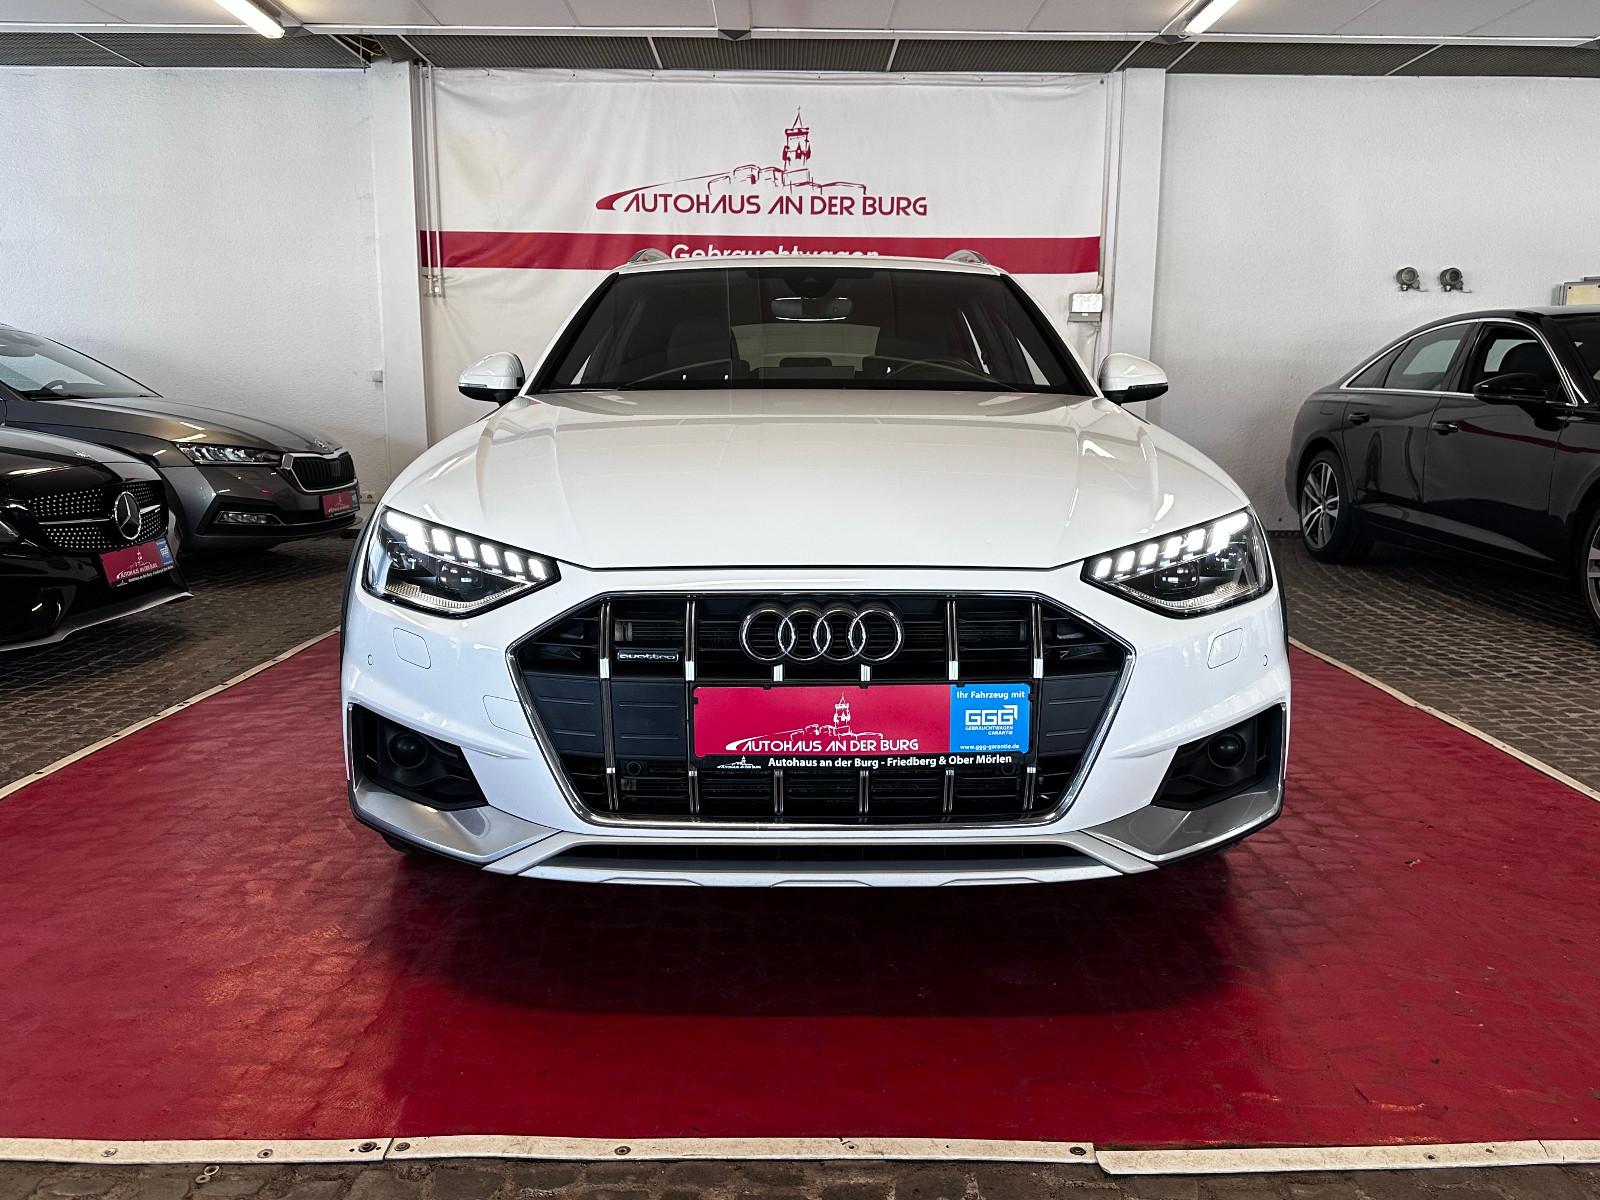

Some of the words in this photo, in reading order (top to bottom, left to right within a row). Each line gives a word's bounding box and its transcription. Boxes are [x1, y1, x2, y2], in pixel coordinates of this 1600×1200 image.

[623, 193, 761, 214] AUTOHAUS
[767, 195, 803, 215] AN
[810, 195, 855, 216] DER
[862, 196, 928, 216] BURG
[956, 691, 969, 699] Ihr
[970, 691, 1009, 701] Fahrzeug
[1011, 690, 1026, 699] mit
[965, 709, 1014, 726] GGG
[741, 740, 822, 752] AUTOHAUS
[825, 740, 847, 752] AN
[850, 740, 877, 752] DER
[880, 739, 919, 751] BURG
[960, 743, 1020, 751] www.ggg-garantie.de
[768, 757, 818, 767] Autohaus
[834, 757, 853, 767] der
[854, 758, 879, 769] Burg
[887, 756, 937, 768] Friedberg
[938, 755, 947, 765] &
[948, 755, 975, 765] Ober
[975, 754, 1012, 764] Mörlen
